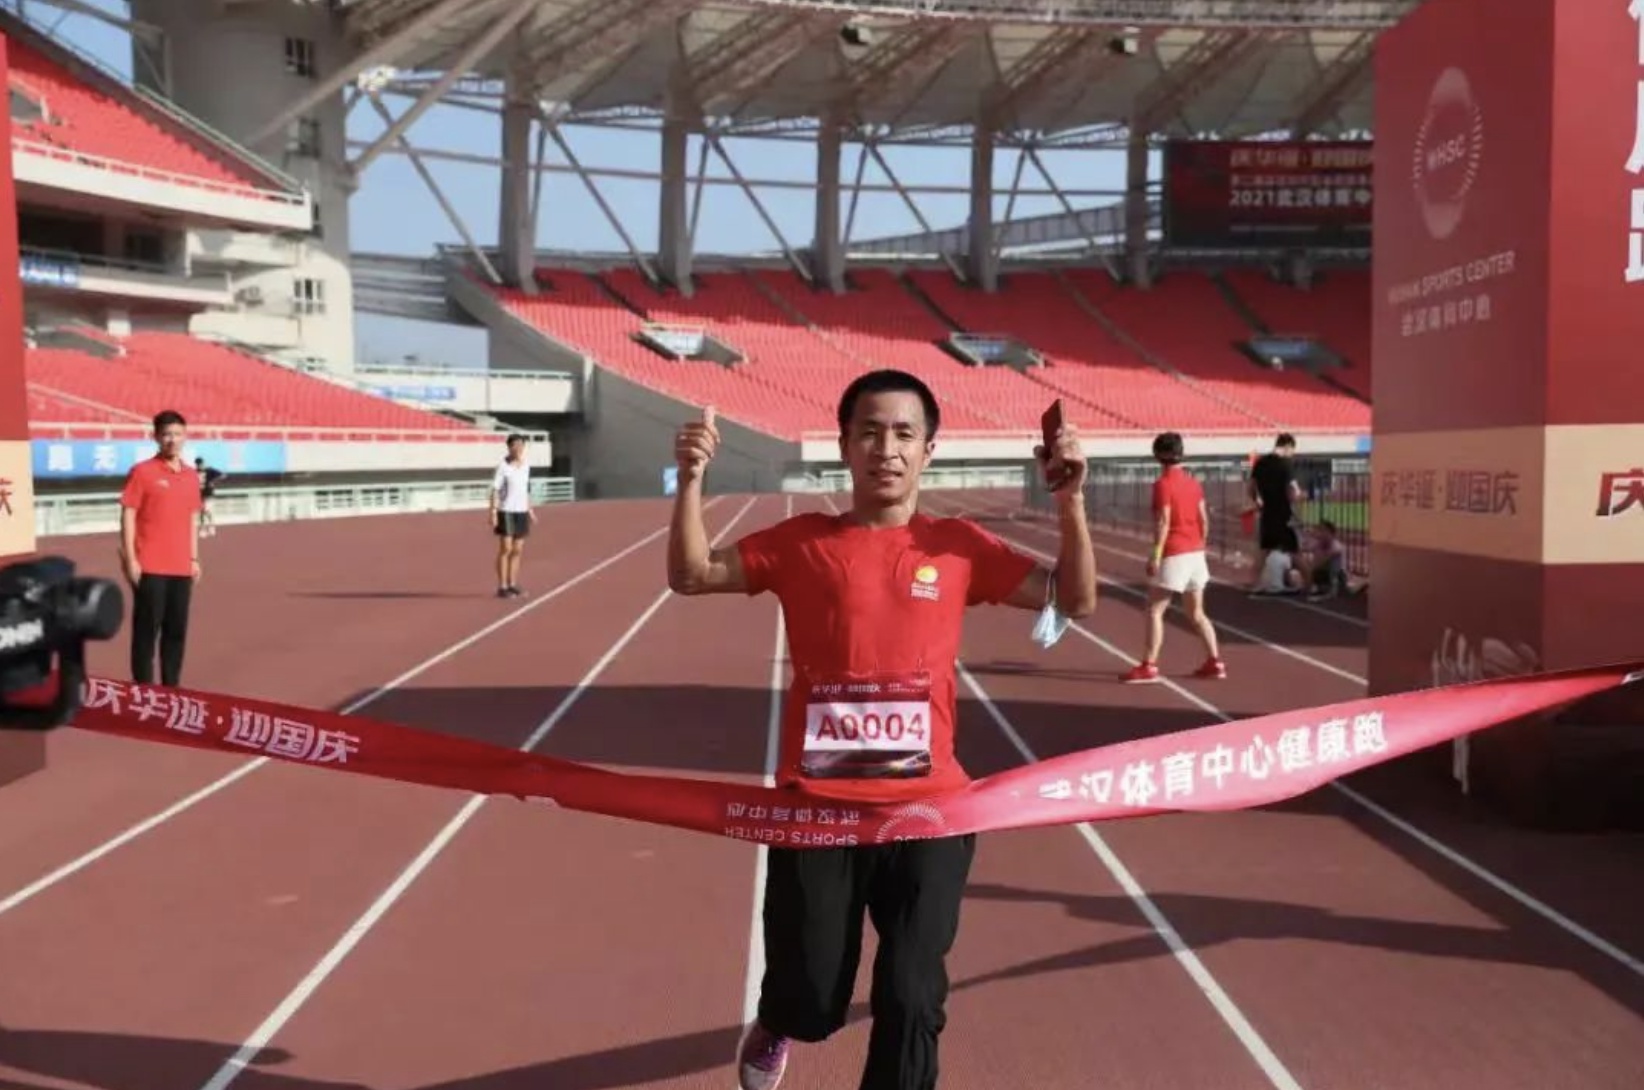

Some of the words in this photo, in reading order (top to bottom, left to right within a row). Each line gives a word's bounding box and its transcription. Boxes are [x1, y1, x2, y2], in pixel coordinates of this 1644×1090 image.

[1422, 266, 1464, 296] SPORTS
[1465, 250, 1516, 282] CENTER
[83, 678, 361, 764] 庆华诞·迎国庆
[815, 712, 925, 741] A0004
[726, 826, 785, 842] CENTER
[791, 830, 859, 846] SPORTS
